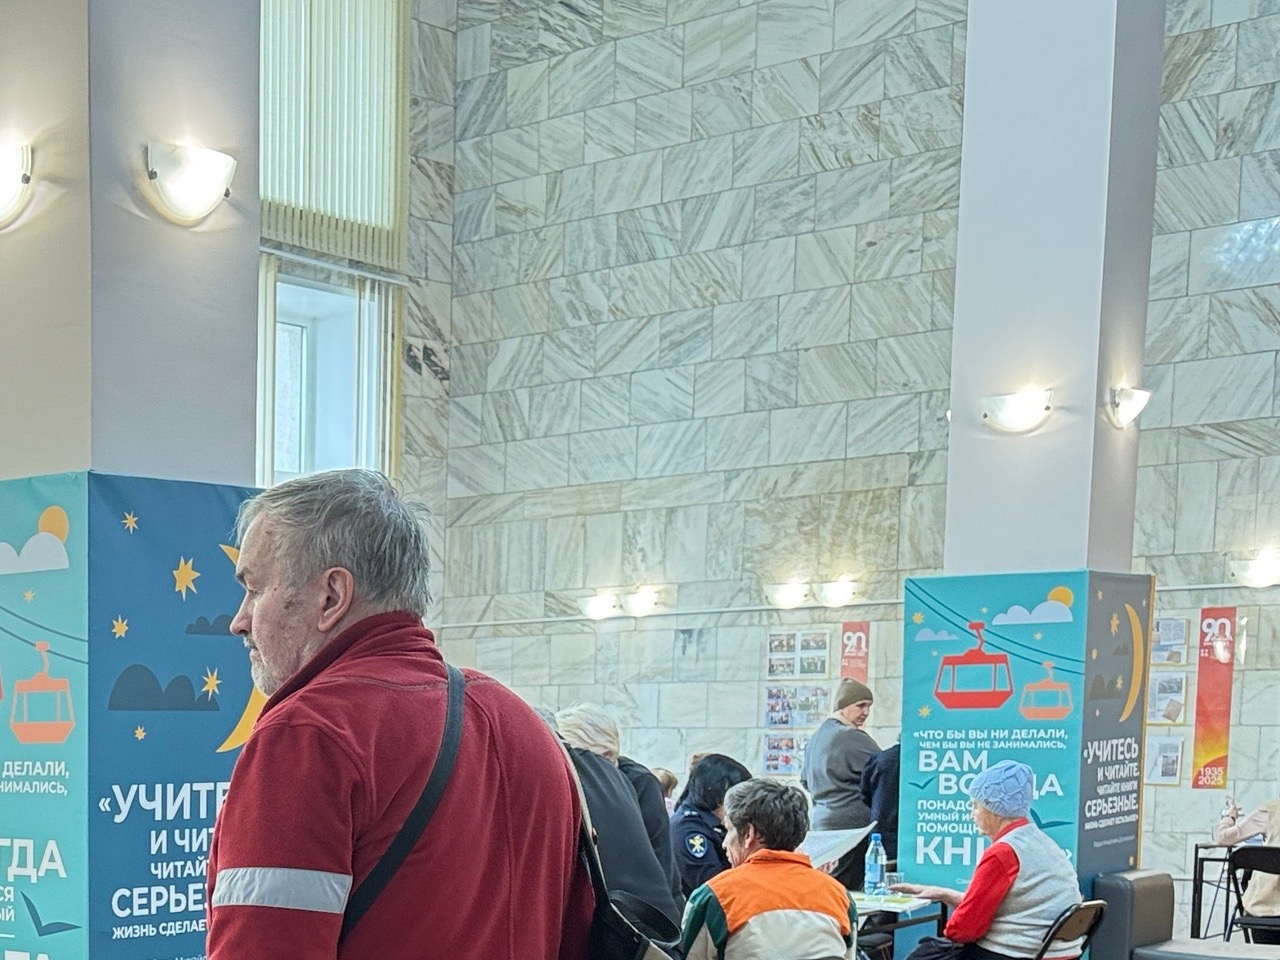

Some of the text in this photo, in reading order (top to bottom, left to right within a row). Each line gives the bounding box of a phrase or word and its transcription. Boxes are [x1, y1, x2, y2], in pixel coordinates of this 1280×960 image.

[913, 729, 1068, 740] «ЧТО БЫ ВЫ НИ ДЕЛАЛИ,
[919, 741, 1066, 749] ЧЕМ БЫ ВЫ НЕ ЗАНИМАЛИСЬ,
[918, 750, 988, 772] ВАМ
[2, 761, 69, 778] ДЕЛАЛИ,
[1097, 767, 1103, 782] И
[1198, 775, 1224, 786] 2025
[917, 811, 959, 821] УМНЫЙ
[150, 829, 167, 855] И
[150, 856, 209, 880] ЧИТАЙ
[111, 882, 208, 918] СЕРЬЕ
[112, 924, 157, 940] ЖИЗНЬ
